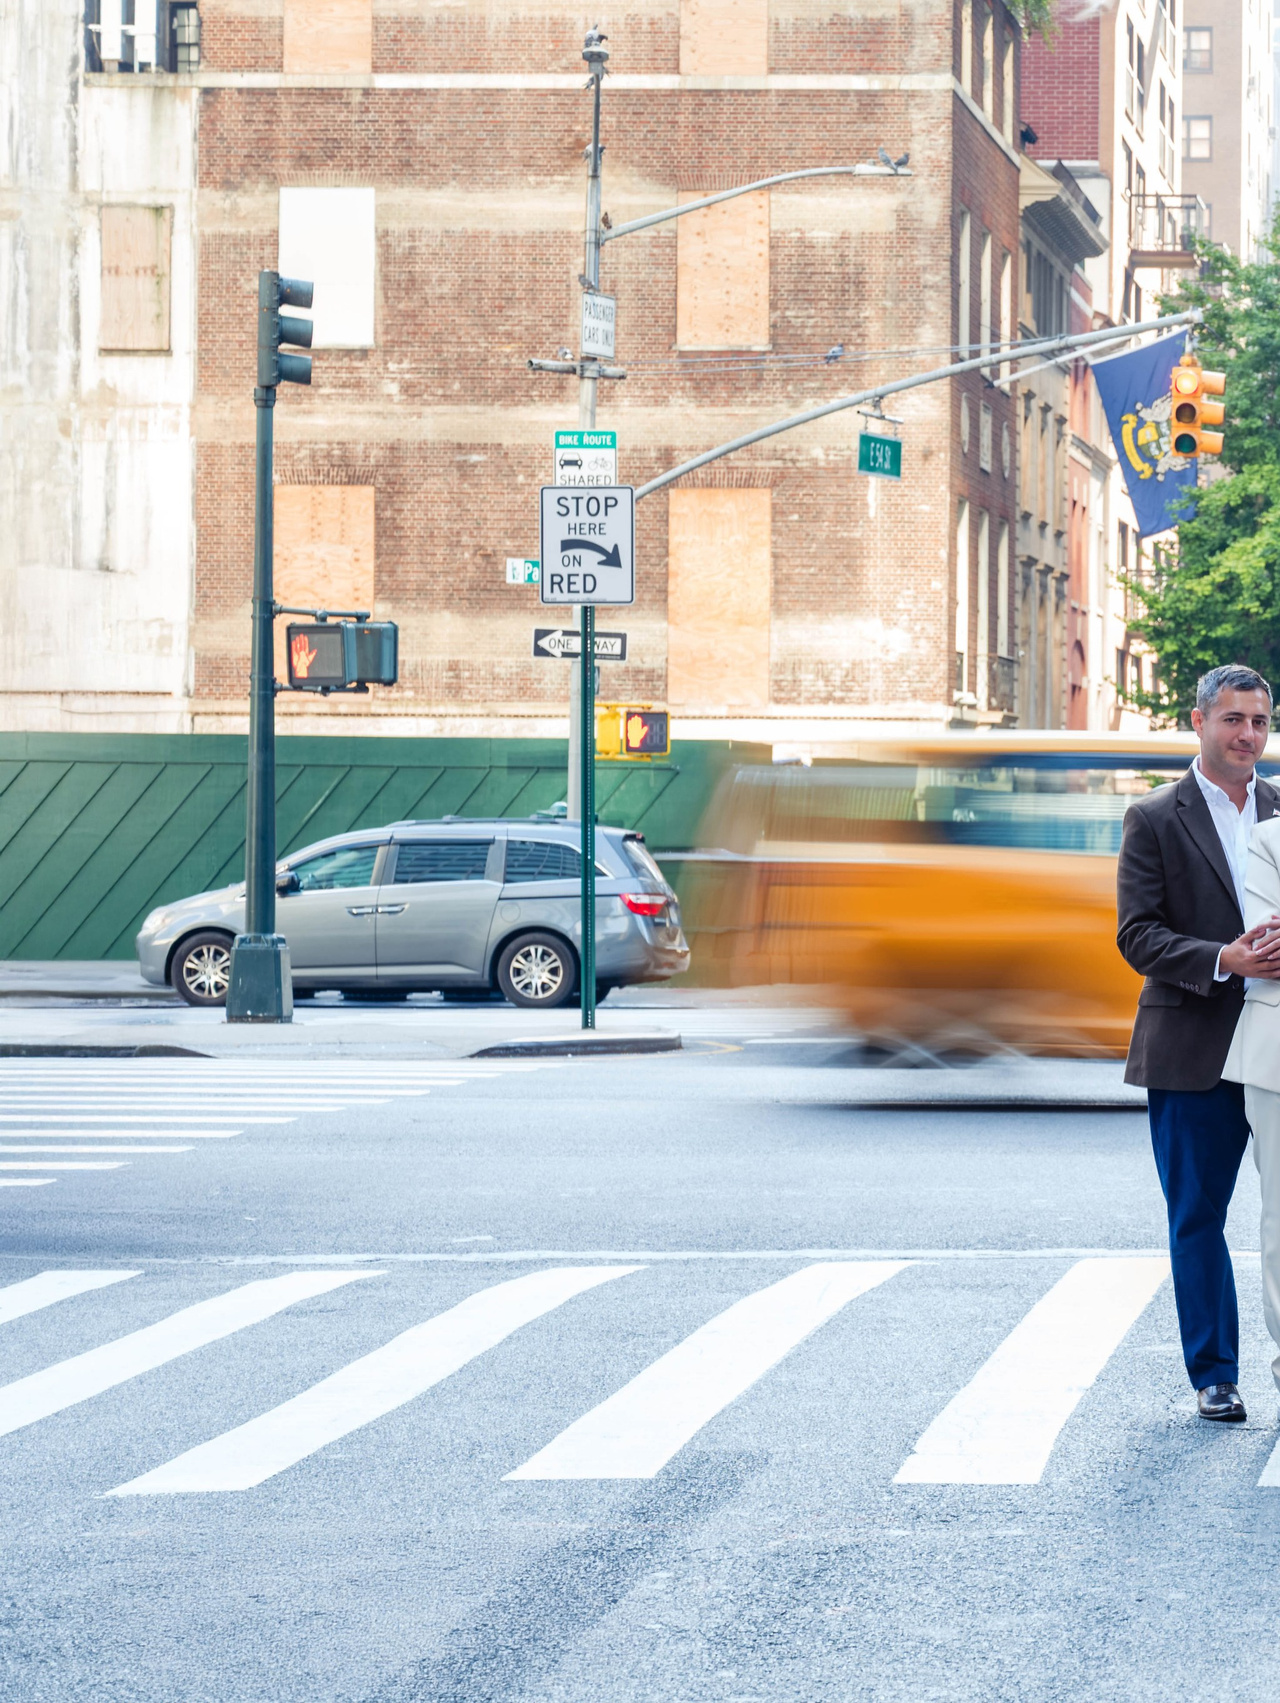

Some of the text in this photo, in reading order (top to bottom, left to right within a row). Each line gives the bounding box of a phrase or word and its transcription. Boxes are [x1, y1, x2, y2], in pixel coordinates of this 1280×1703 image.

[584, 300, 614, 323] PASSENGER
[584, 325, 614, 348] CARS ONLY
[559, 433, 613, 446] BIKE ROUTE
[870, 442, 875, 467] E
[560, 475, 612, 487] SHARED
[556, 496, 619, 517] STOP
[567, 523, 607, 535] HERE
[561, 555, 582, 567] ON
[550, 573, 597, 594] RED
[548, 638, 573, 651] ONE
